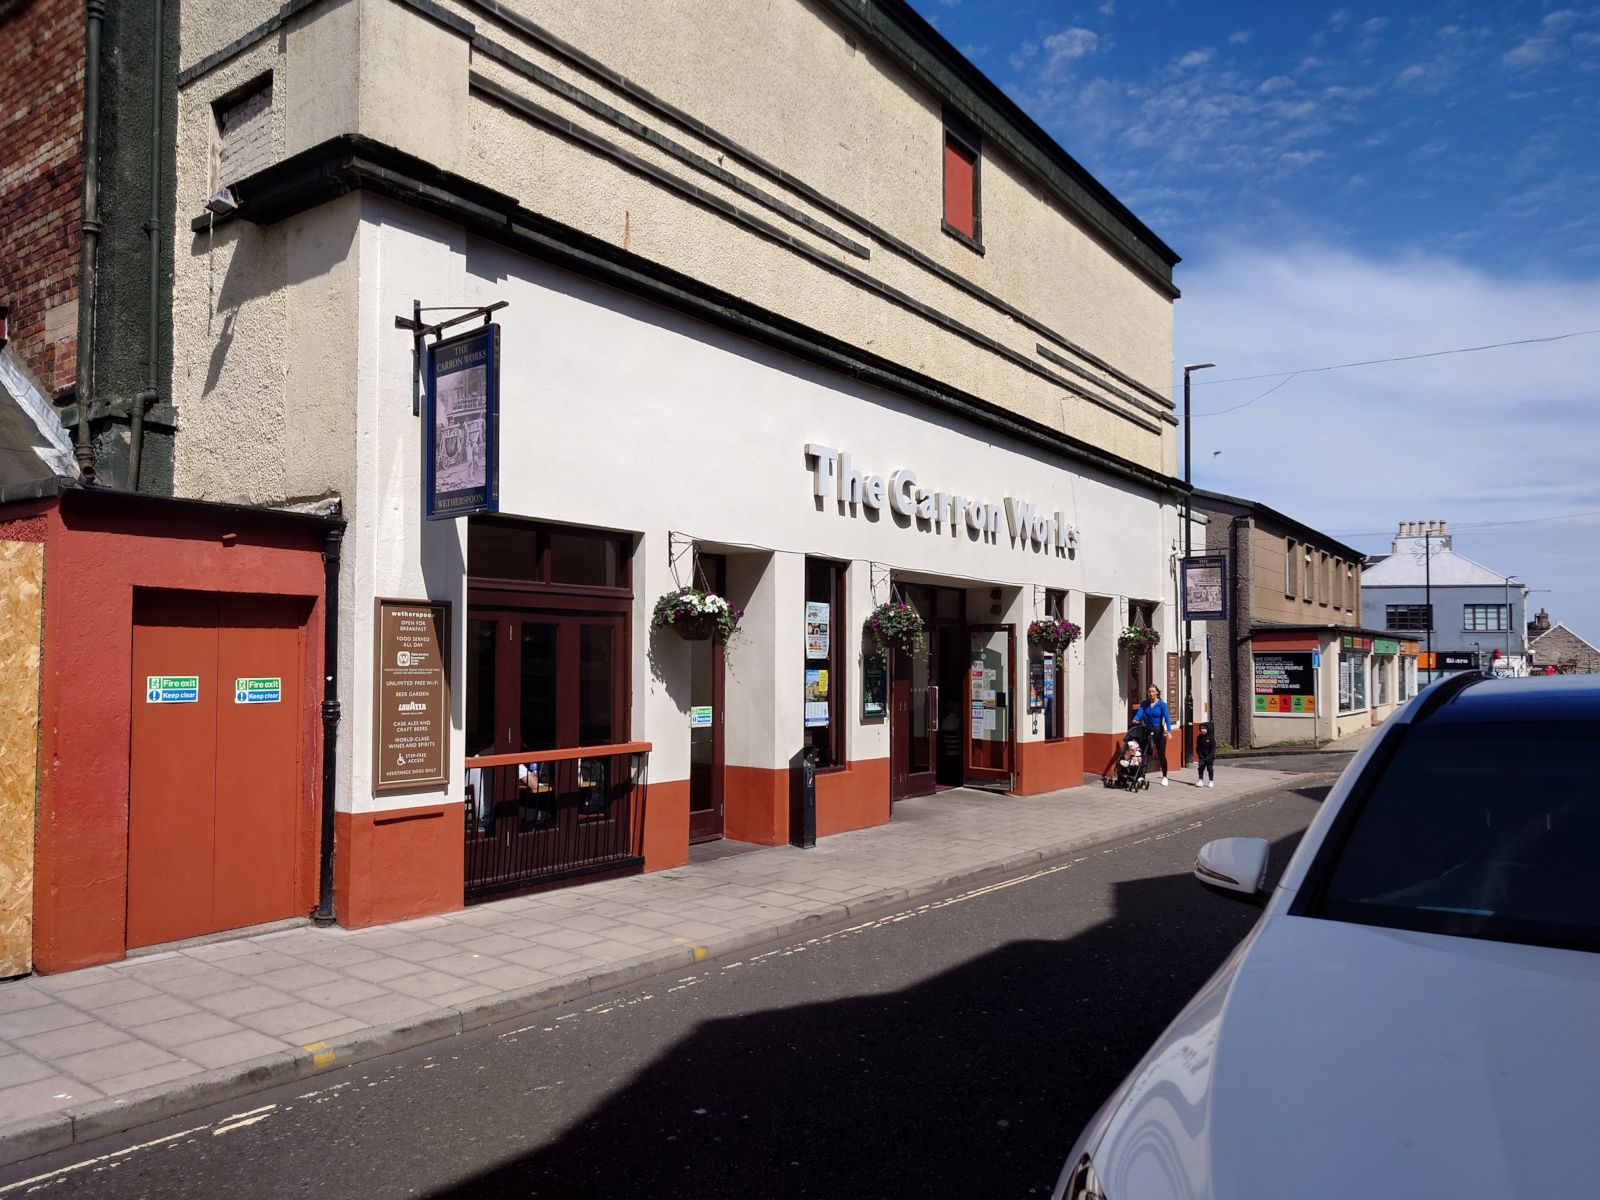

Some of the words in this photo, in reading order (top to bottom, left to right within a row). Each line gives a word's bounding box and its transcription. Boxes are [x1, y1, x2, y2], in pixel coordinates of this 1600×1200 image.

[456, 344, 468, 356] THE
[437, 358, 463, 372] CARRON
[464, 351, 486, 363] WORKS
[438, 494, 484, 508] WETHERSPOON
[804, 443, 885, 509] The
[888, 468, 1000, 533] Carron
[1004, 496, 1081, 549] Works
[180, 679, 196, 687] exit
